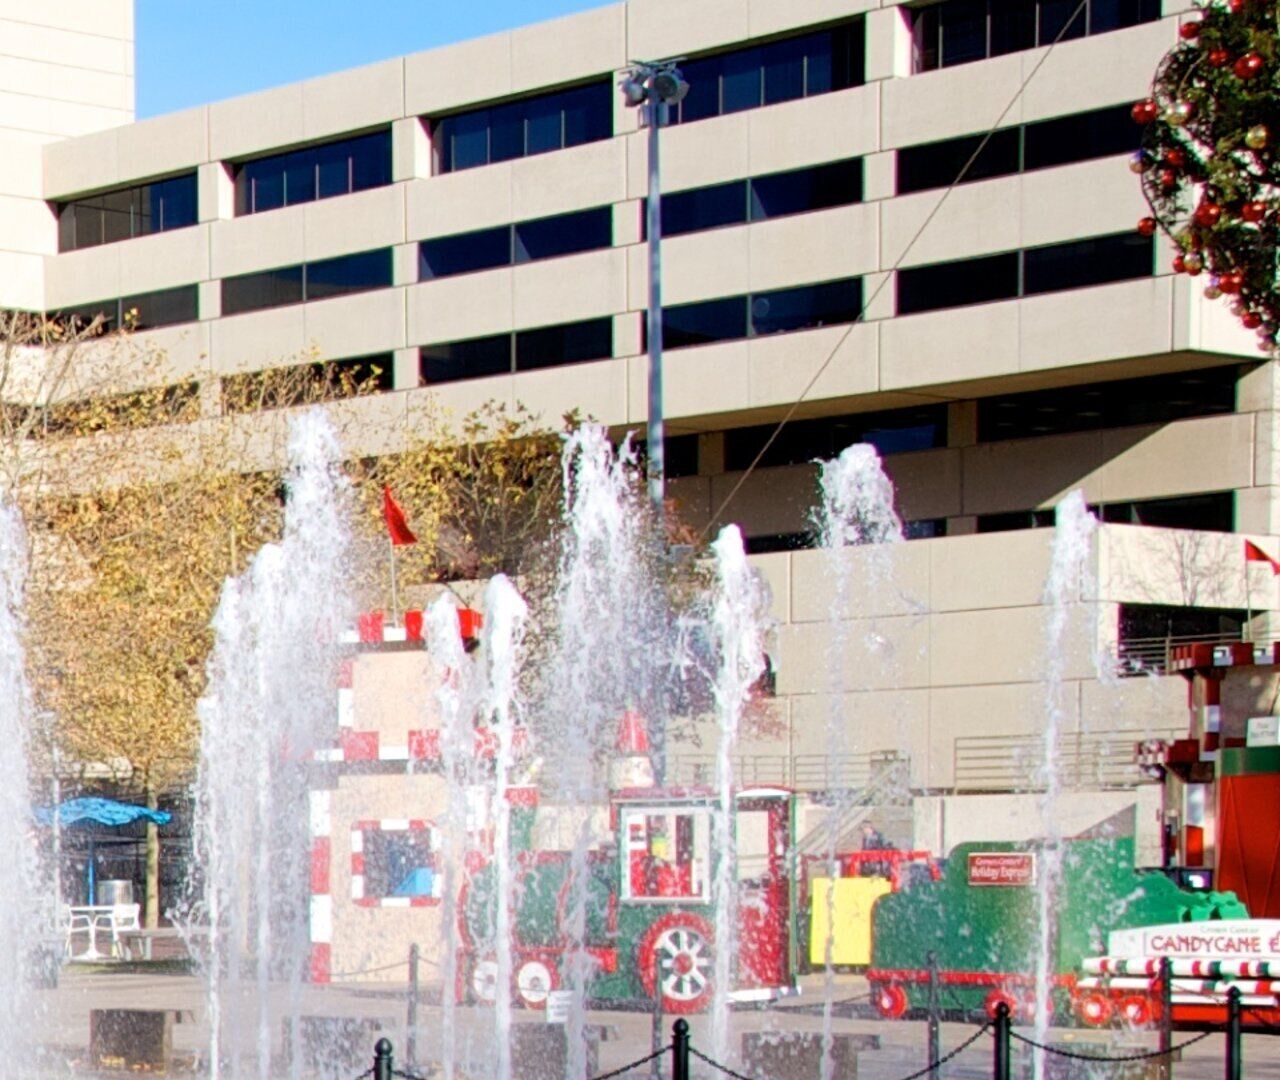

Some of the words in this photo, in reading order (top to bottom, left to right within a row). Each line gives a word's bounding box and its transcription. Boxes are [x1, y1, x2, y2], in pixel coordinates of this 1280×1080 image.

[971, 866, 998, 880] Holiday
[1151, 935, 1261, 953] CANDYCANE
[1268, 931, 1280, 952] E
